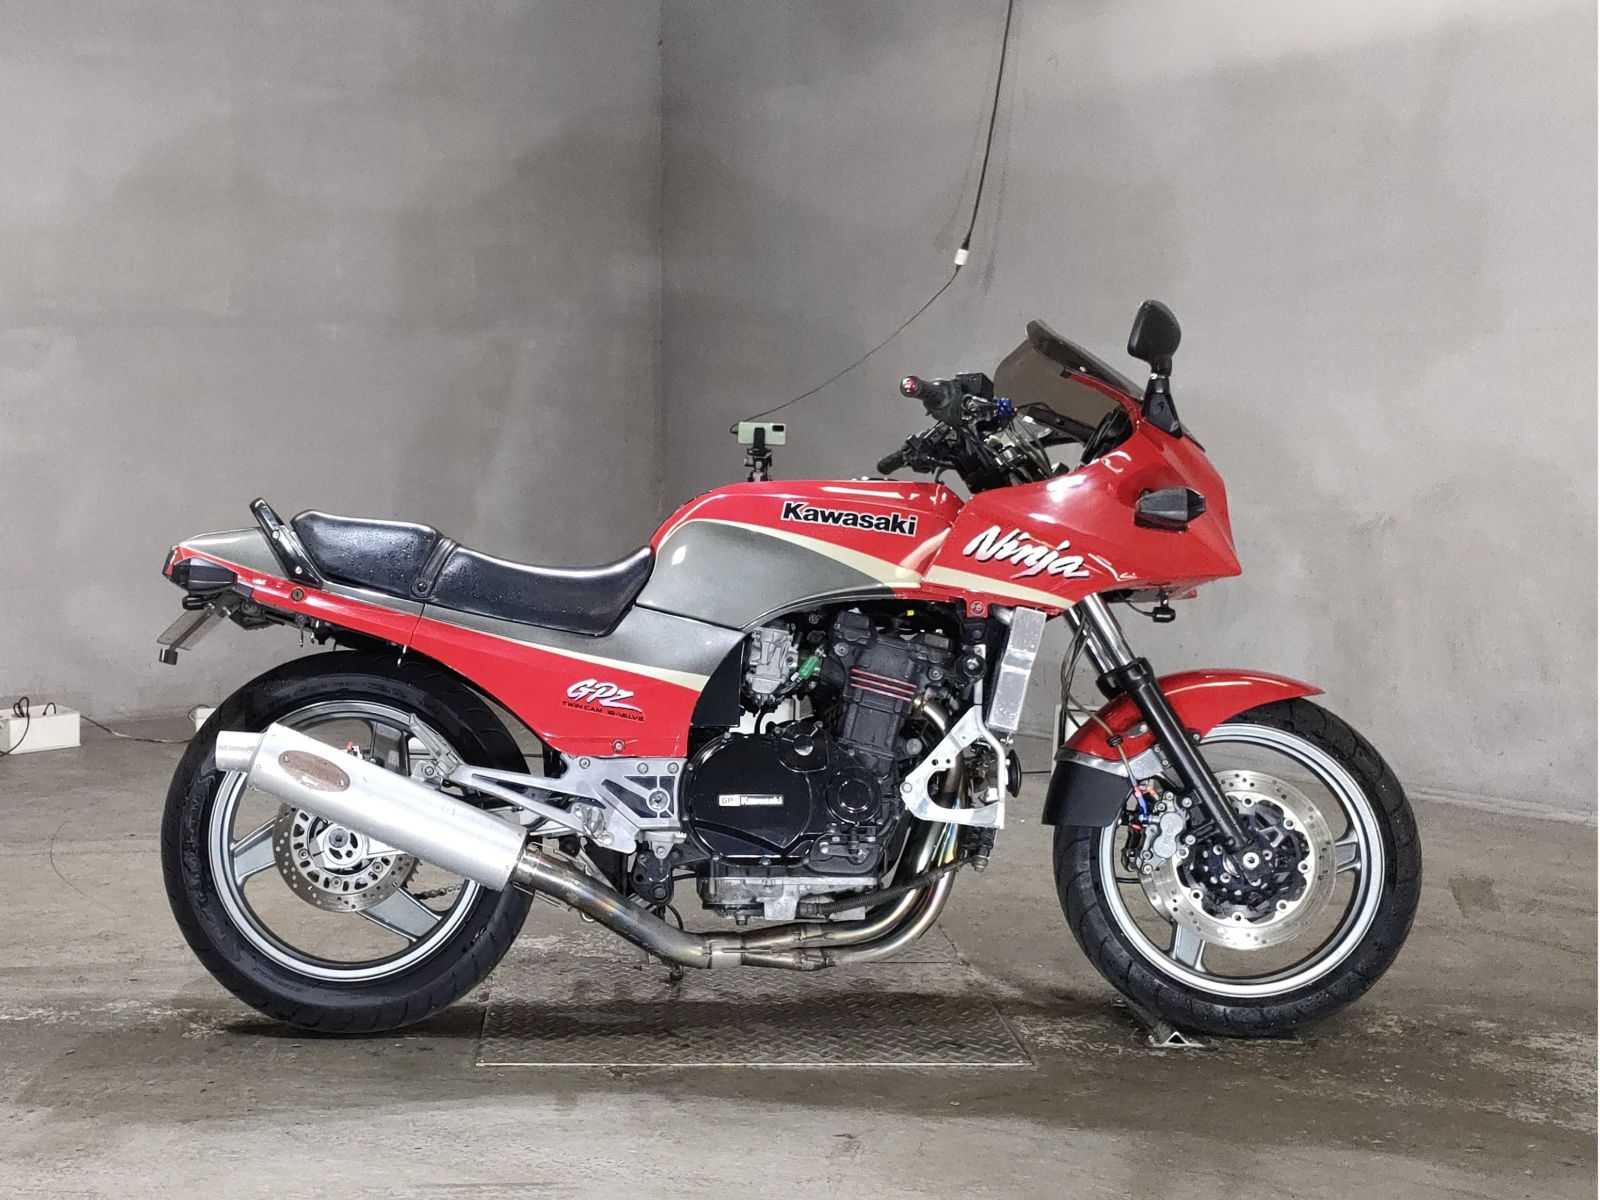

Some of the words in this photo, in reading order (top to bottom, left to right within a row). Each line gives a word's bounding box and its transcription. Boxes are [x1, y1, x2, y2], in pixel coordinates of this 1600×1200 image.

[782, 502, 917, 536] Kawasaki
[962, 525, 1090, 579] Ninja
[562, 701, 582, 709] TWIN
[584, 705, 603, 713] CAM
